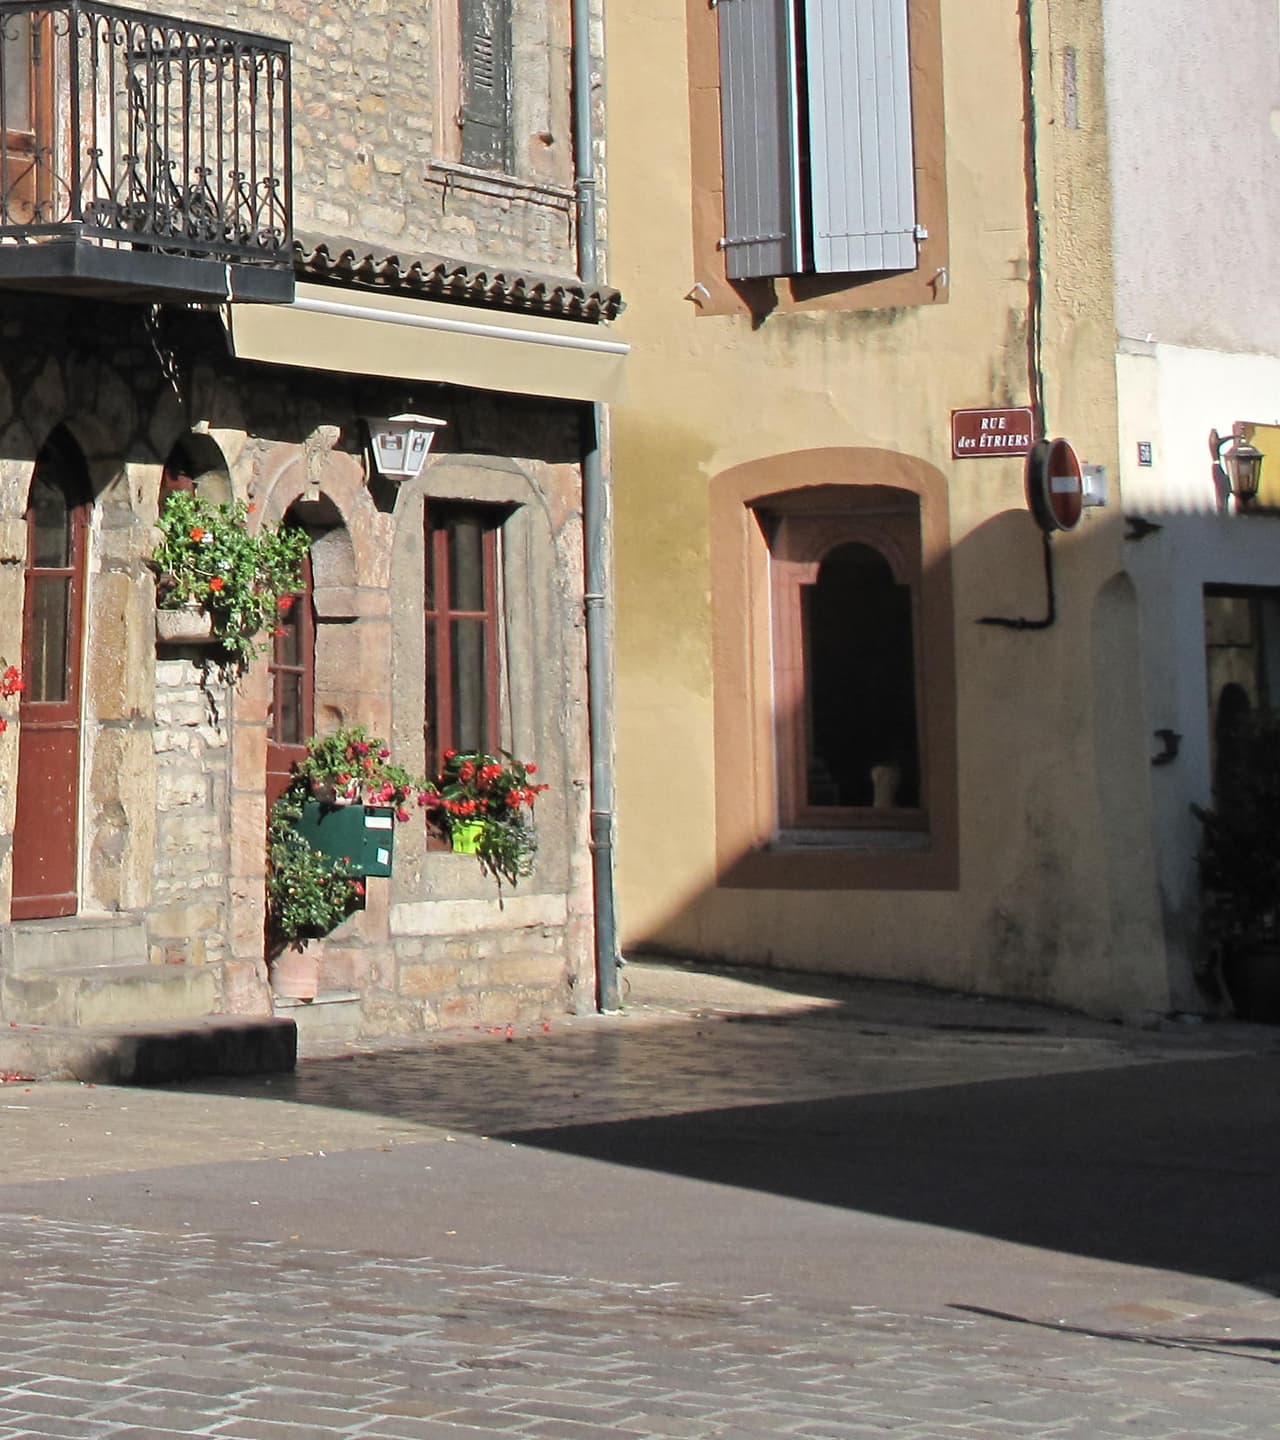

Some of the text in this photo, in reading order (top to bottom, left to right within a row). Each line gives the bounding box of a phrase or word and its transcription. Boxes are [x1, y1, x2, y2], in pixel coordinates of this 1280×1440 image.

[981, 417, 1006, 430] RUE
[958, 433, 1029, 448] des ÉTRIERS
